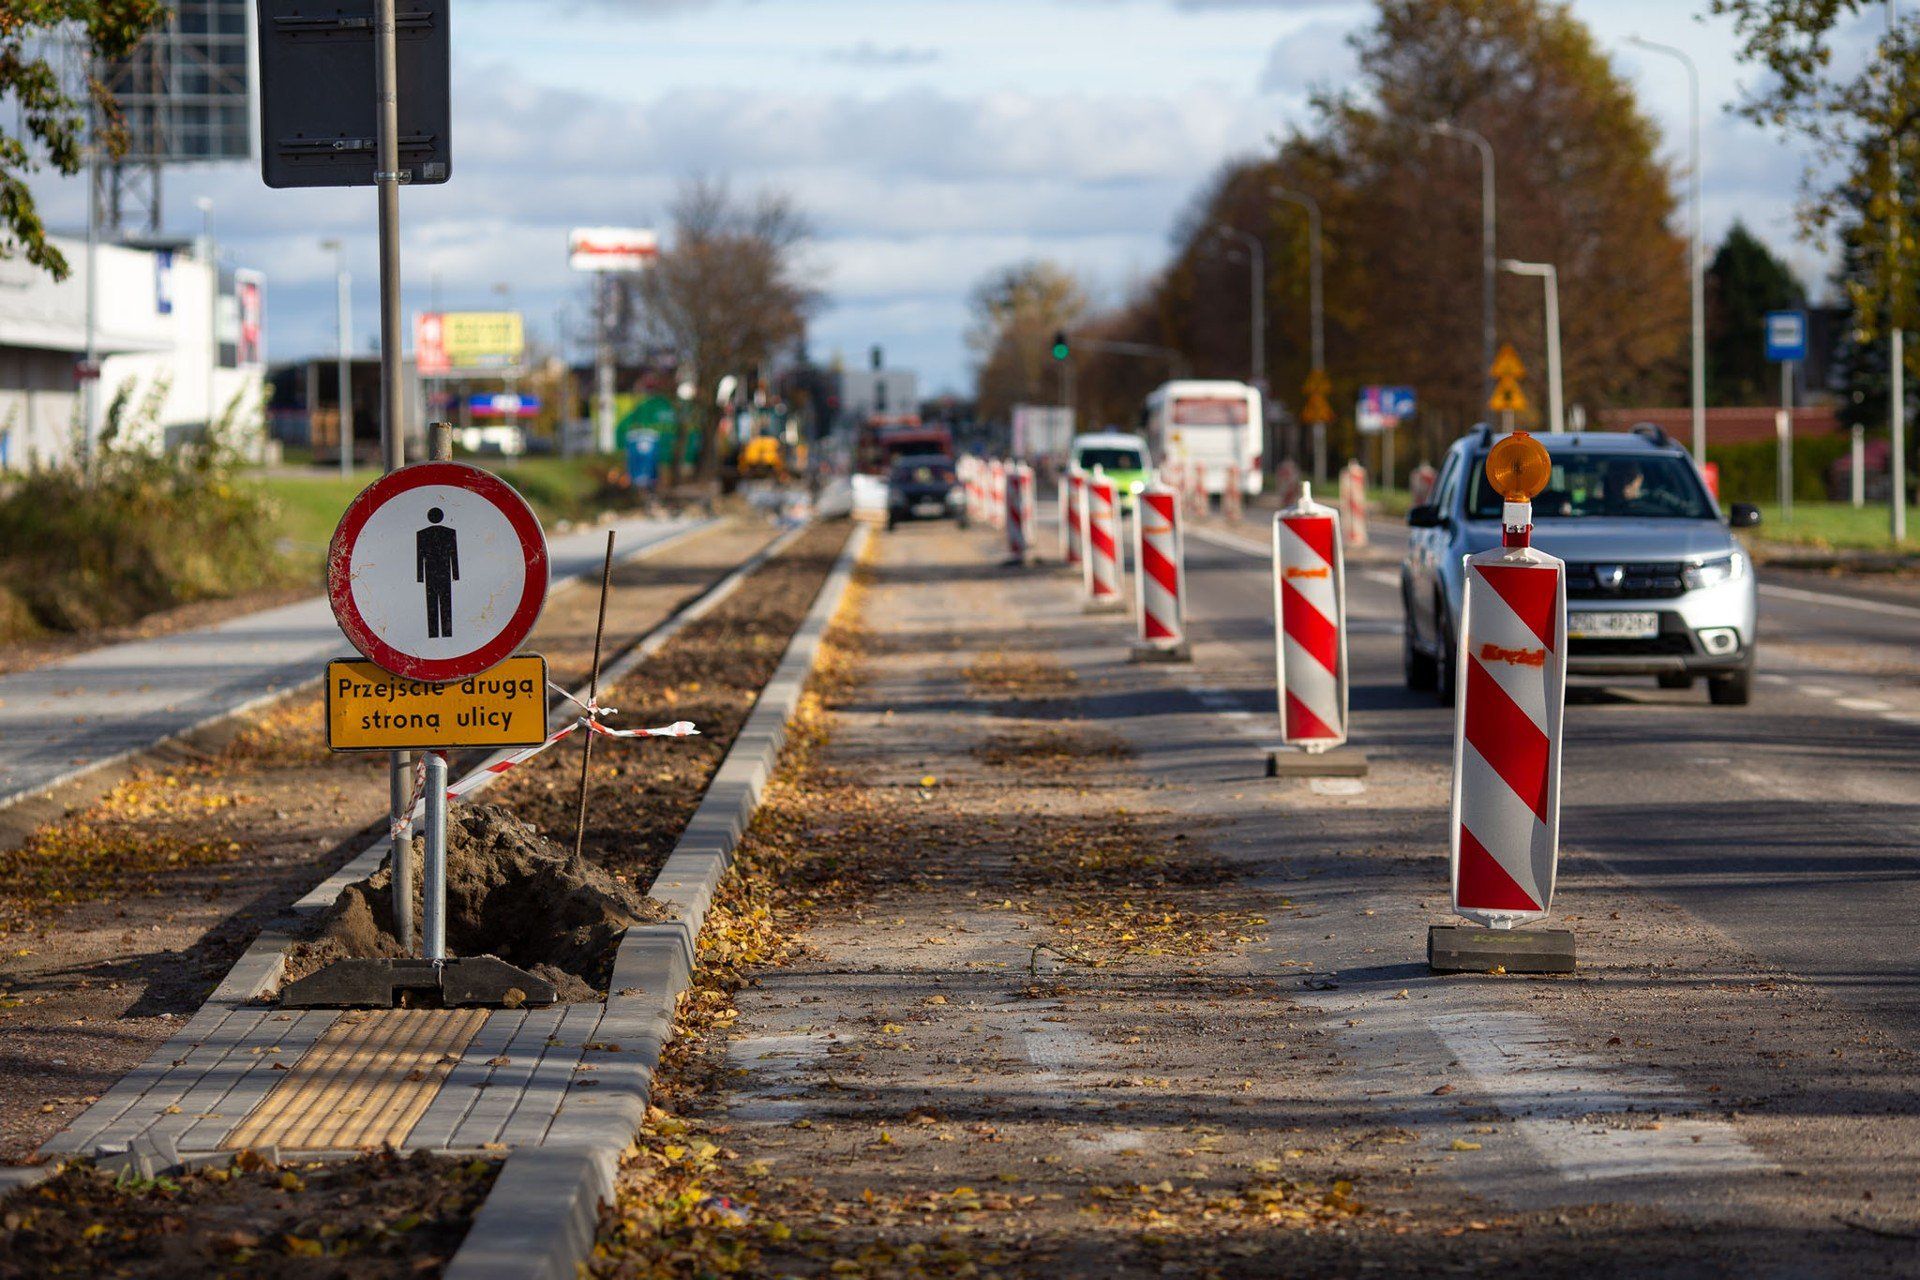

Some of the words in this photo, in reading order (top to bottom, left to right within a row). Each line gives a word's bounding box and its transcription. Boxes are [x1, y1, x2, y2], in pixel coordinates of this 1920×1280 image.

[461, 677, 534, 699] drugą
[361, 710, 440, 733] stroną
[457, 706, 513, 731] ulicy
